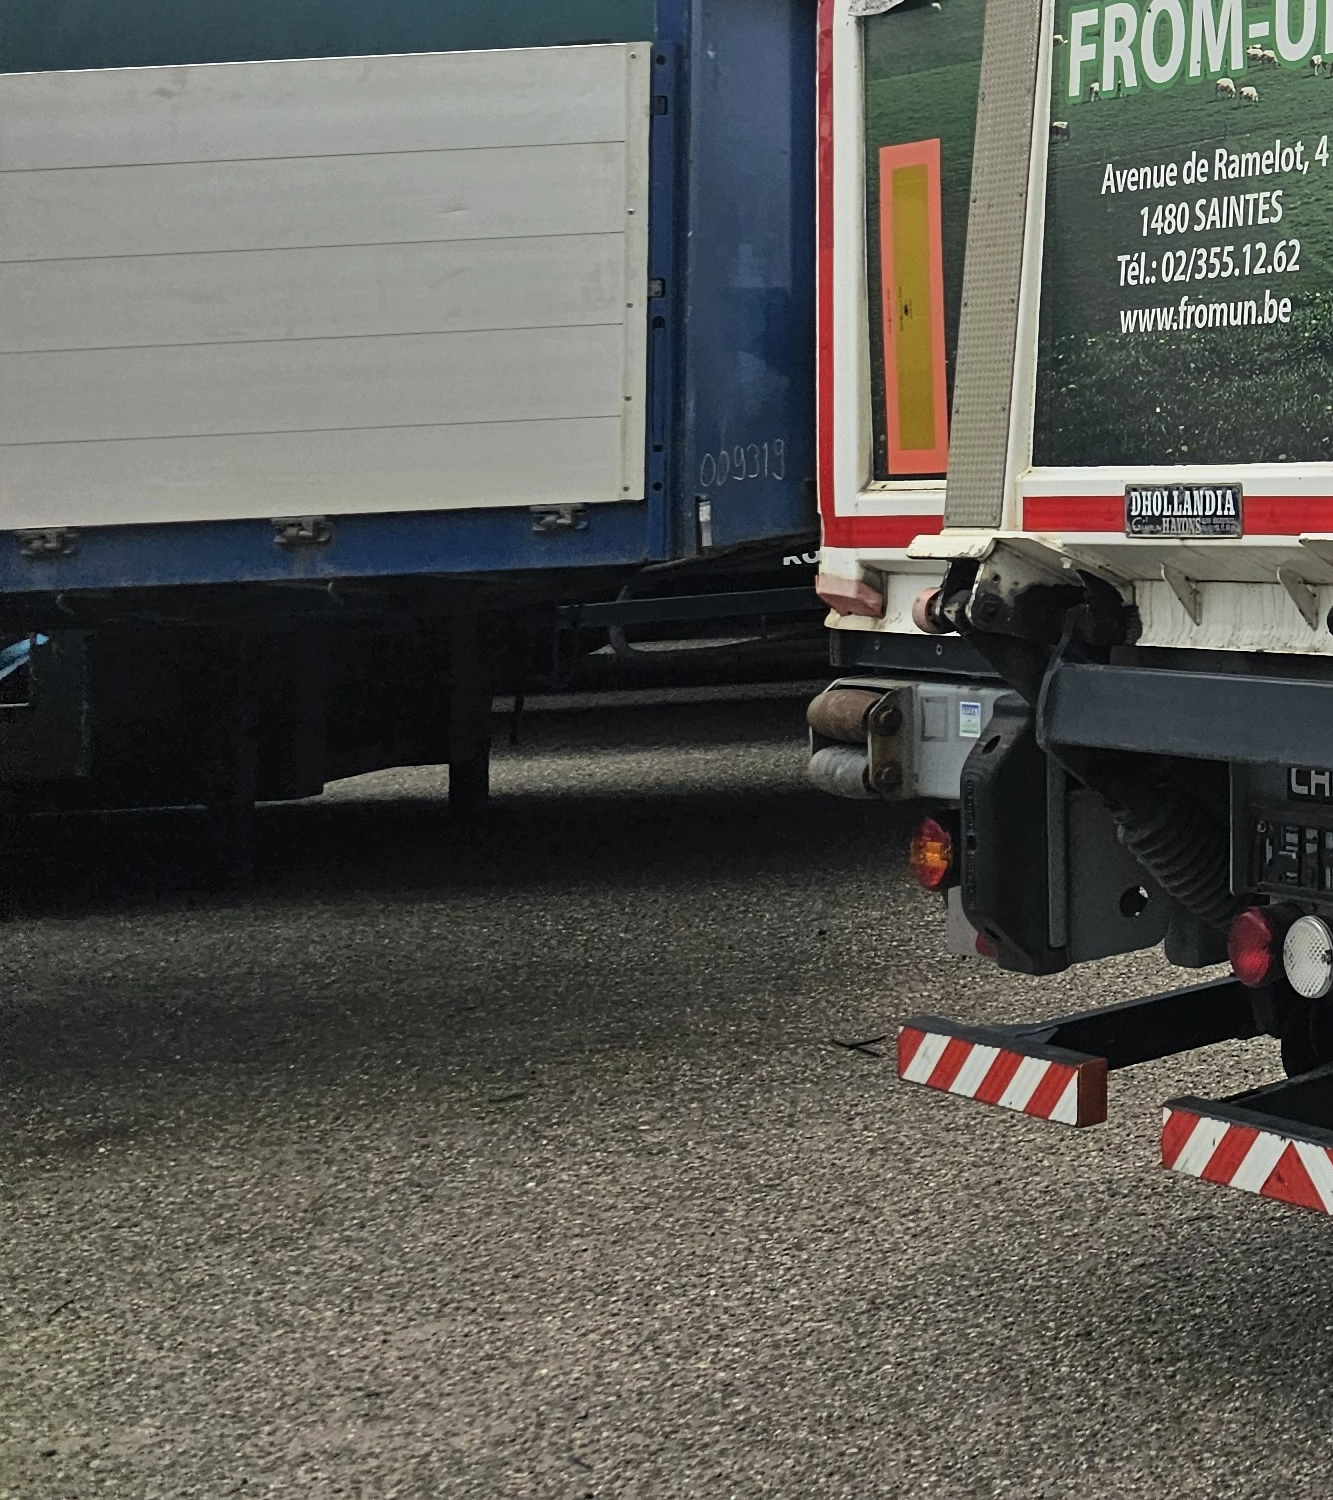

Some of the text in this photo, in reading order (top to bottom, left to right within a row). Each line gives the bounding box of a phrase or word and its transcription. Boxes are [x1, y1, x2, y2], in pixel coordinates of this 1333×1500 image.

[1101, 135, 1329, 194] Avenue de Ramelot, 4
[1140, 190, 1283, 236] 1480 SAINTES
[1117, 239, 1300, 286] Tél.: 02/355.12.62
[1120, 290, 1292, 333] www.fromun.be
[1130, 489, 1236, 516] DHOLLANDIA
[1161, 517, 1201, 534] HAYONS
